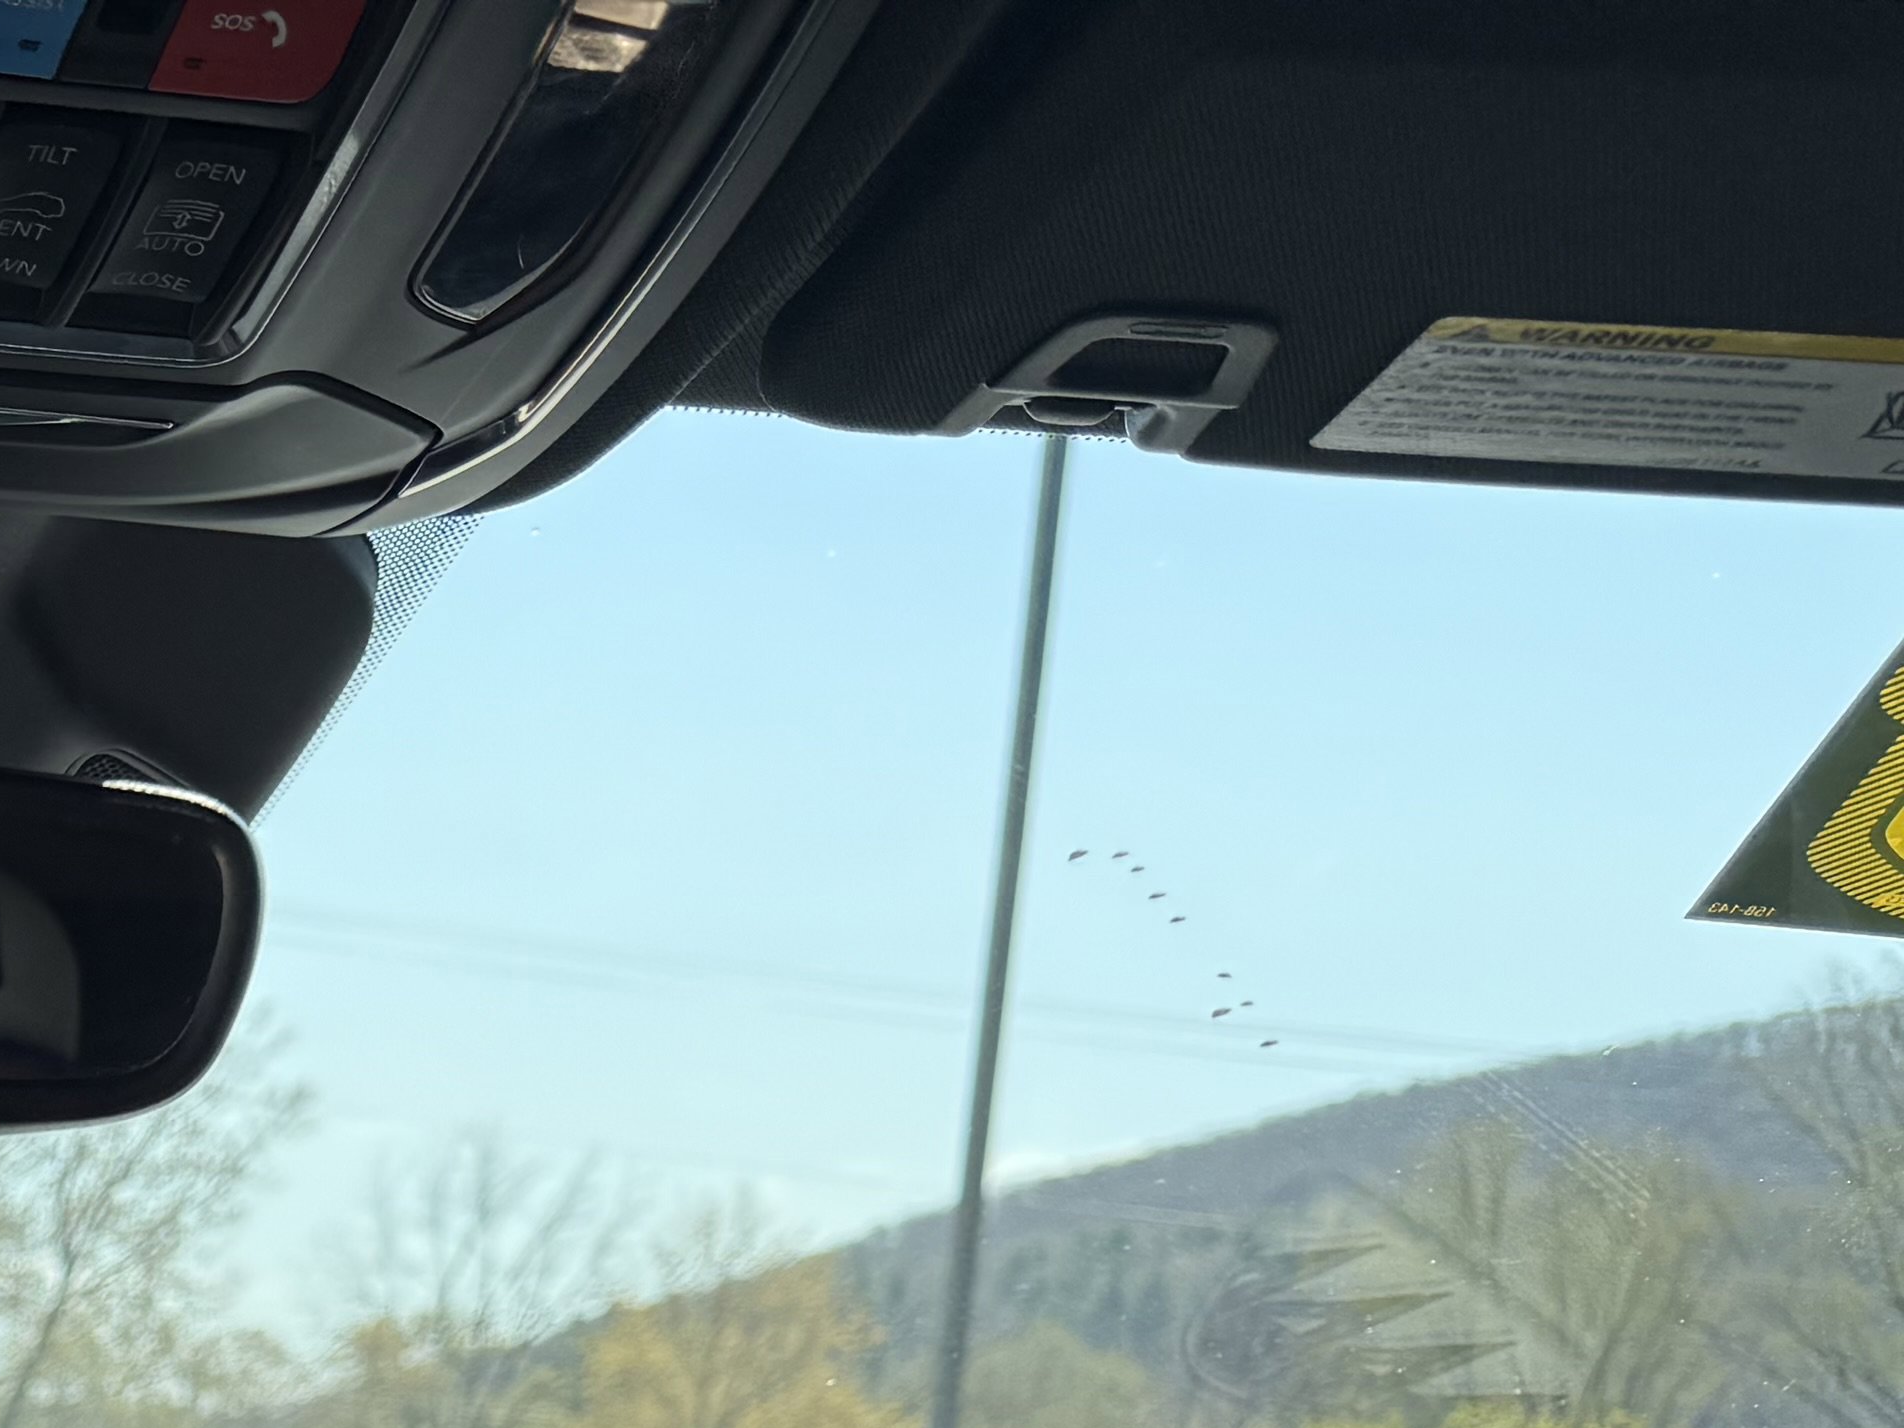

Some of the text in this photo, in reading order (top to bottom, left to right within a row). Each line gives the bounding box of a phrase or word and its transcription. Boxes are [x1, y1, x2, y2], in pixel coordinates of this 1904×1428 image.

[211, 13, 254, 32] SOS
[27, 142, 78, 168] TILT
[175, 160, 247, 185] OPEN
[134, 235, 206, 259] AUTO
[111, 269, 191, 294] CLOSE
[1519, 325, 1717, 352] WARNING
